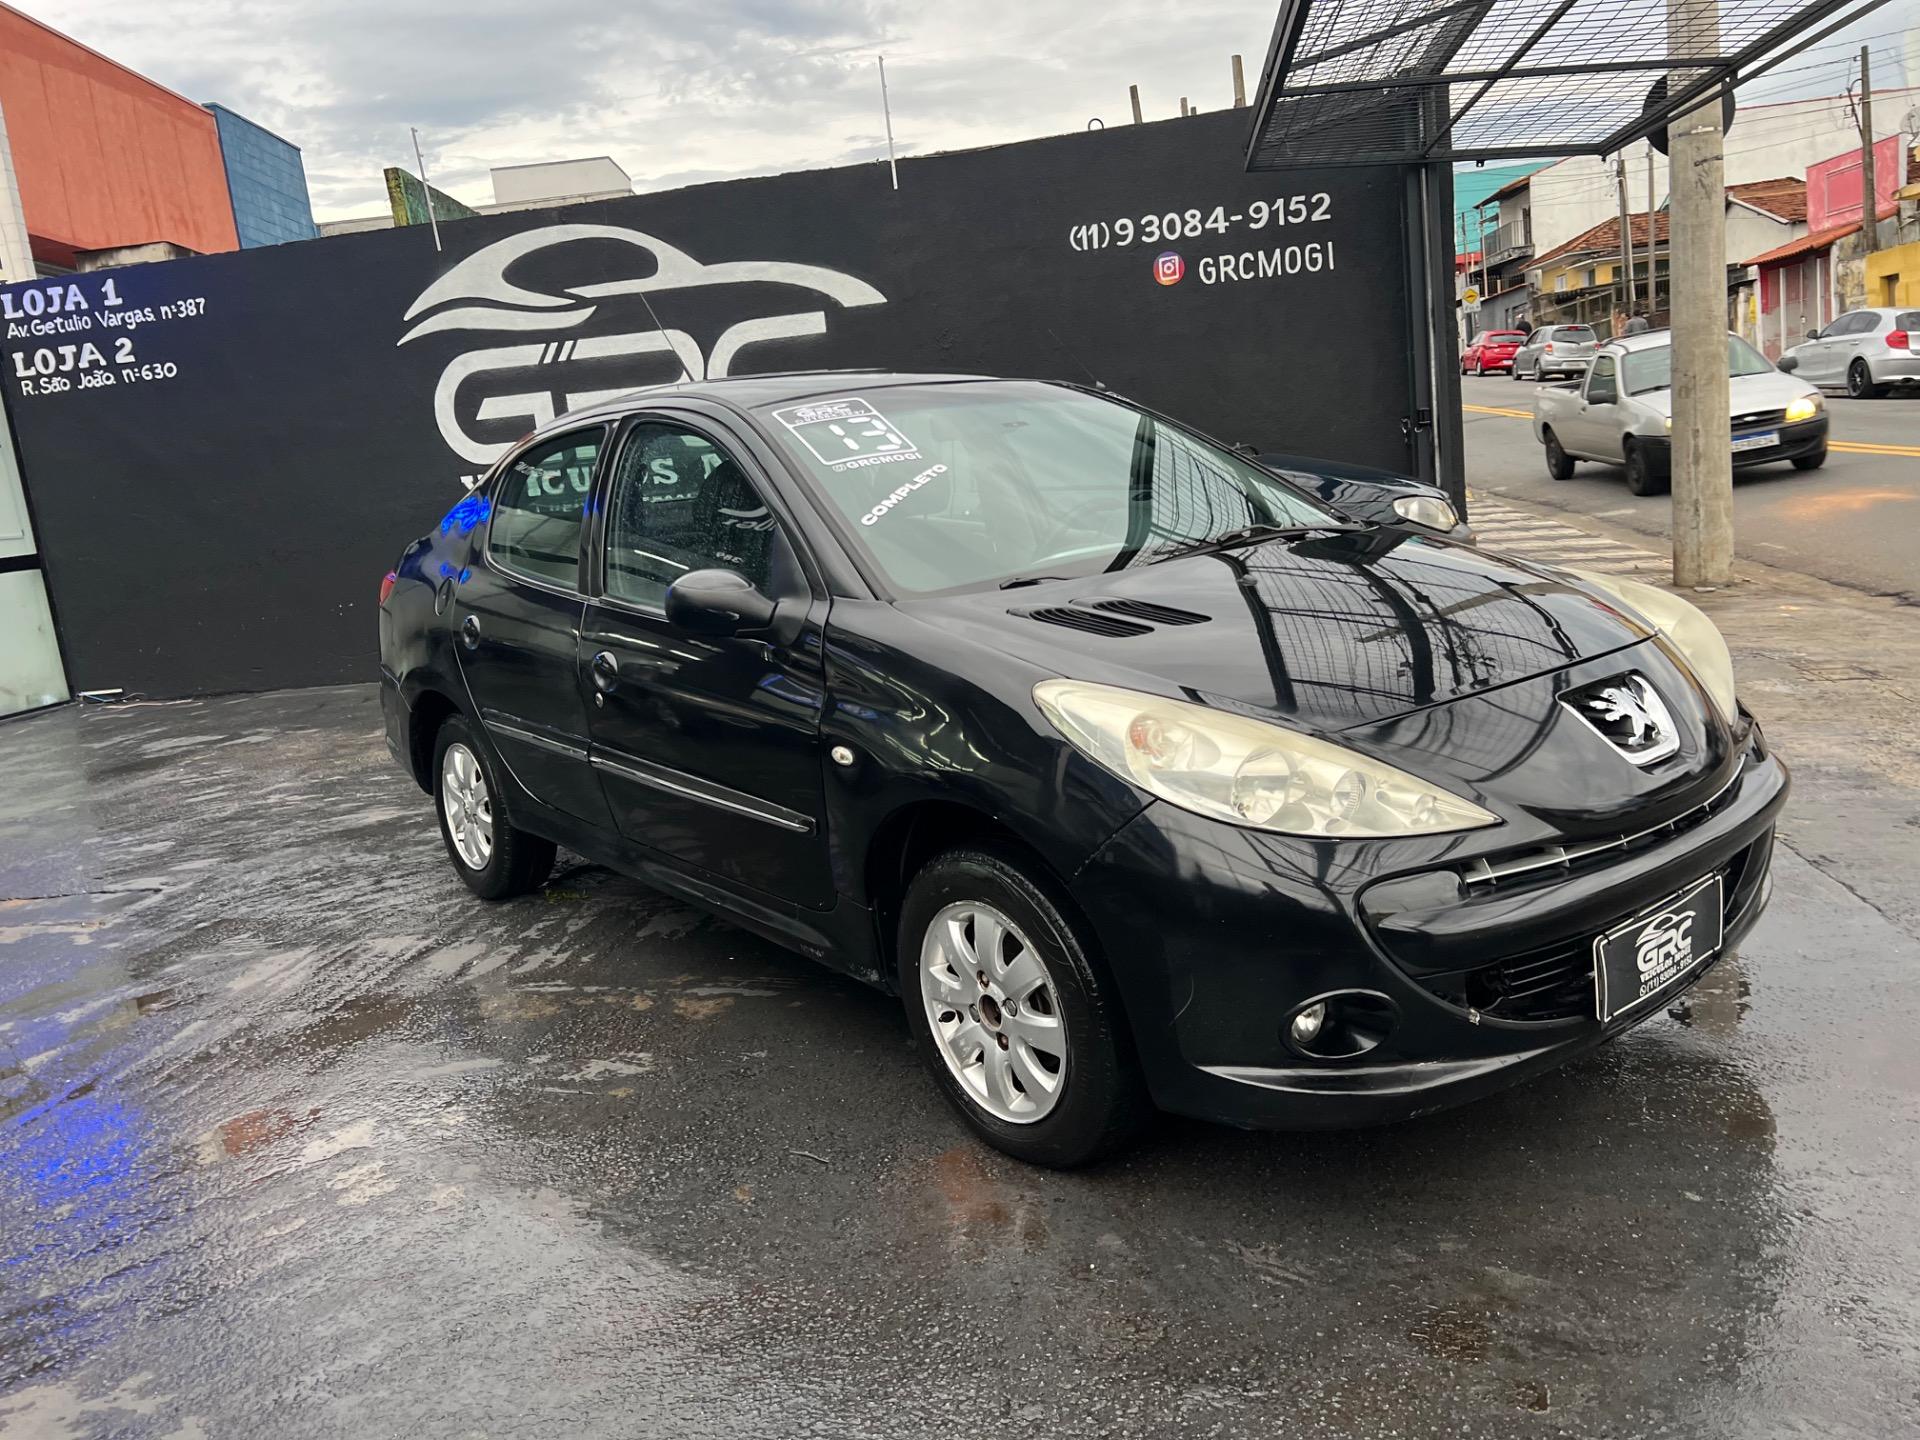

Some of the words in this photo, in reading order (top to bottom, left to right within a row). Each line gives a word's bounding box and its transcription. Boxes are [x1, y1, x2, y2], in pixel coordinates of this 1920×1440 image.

[1199, 241, 1335, 285] GRCMOGI
[0, 284, 89, 319] LOJA
[101, 278, 123, 307] 1
[12, 342, 107, 377] LOJA
[114, 337, 136, 364] 2
[828, 416, 902, 451] 13
[861, 463, 948, 526] COMPLETO
[1637, 916, 1692, 972] GRC
